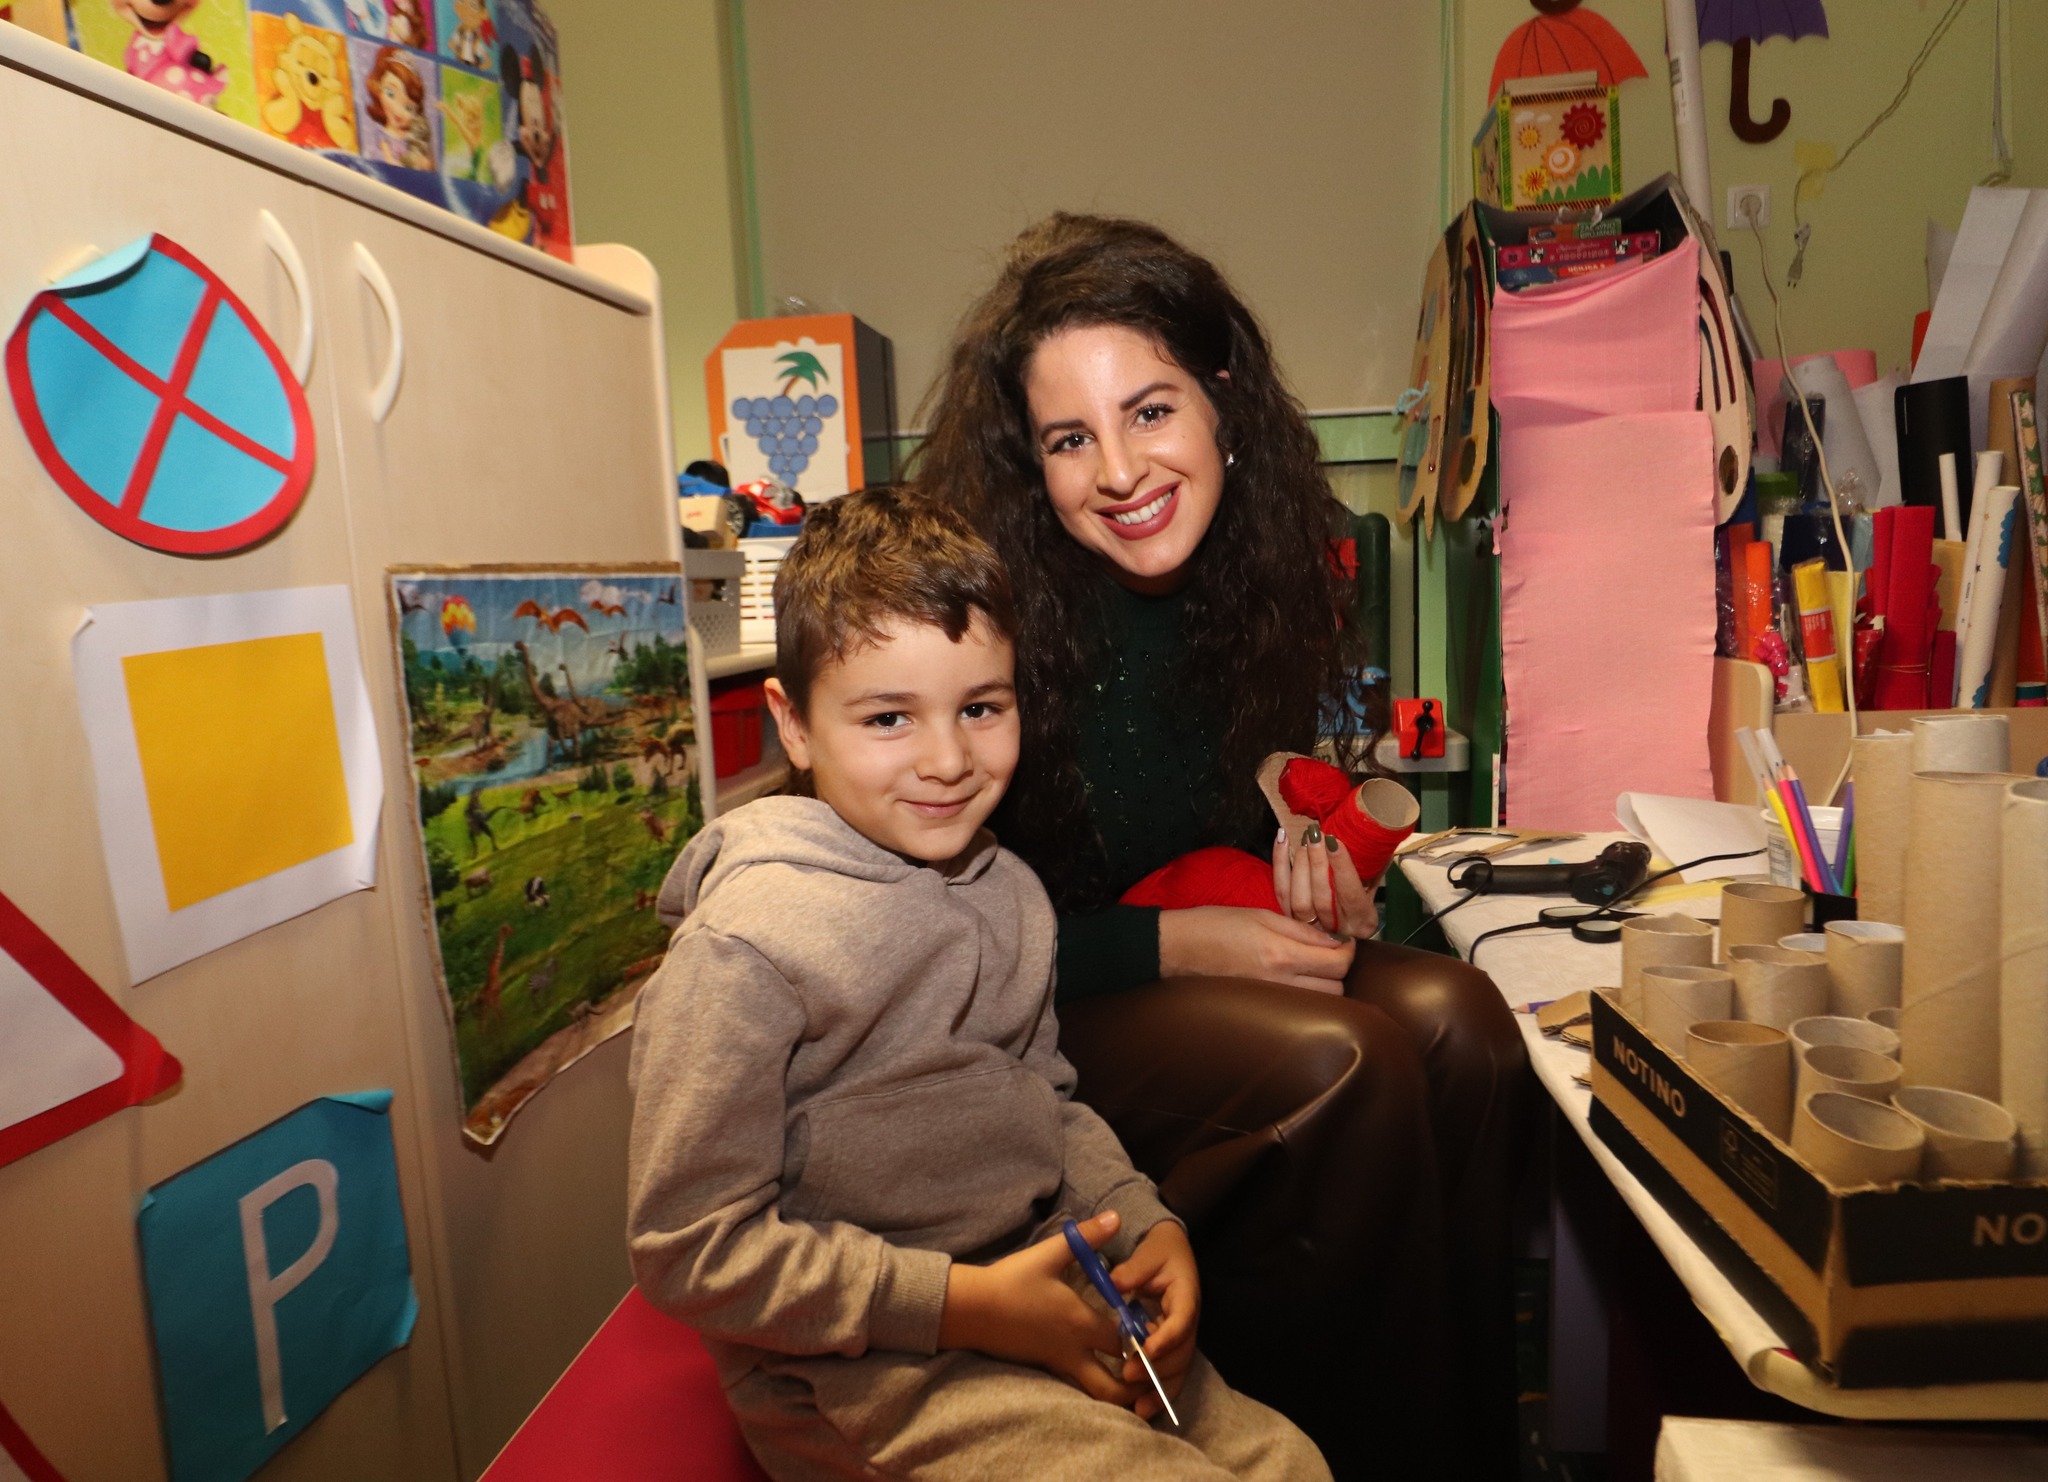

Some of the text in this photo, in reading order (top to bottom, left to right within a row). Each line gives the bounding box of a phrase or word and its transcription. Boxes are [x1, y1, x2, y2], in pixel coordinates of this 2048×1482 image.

[1613, 1035, 1687, 1118] NOTINO
[1974, 1212, 2047, 1246] NO
[239, 1158, 339, 1436] P
